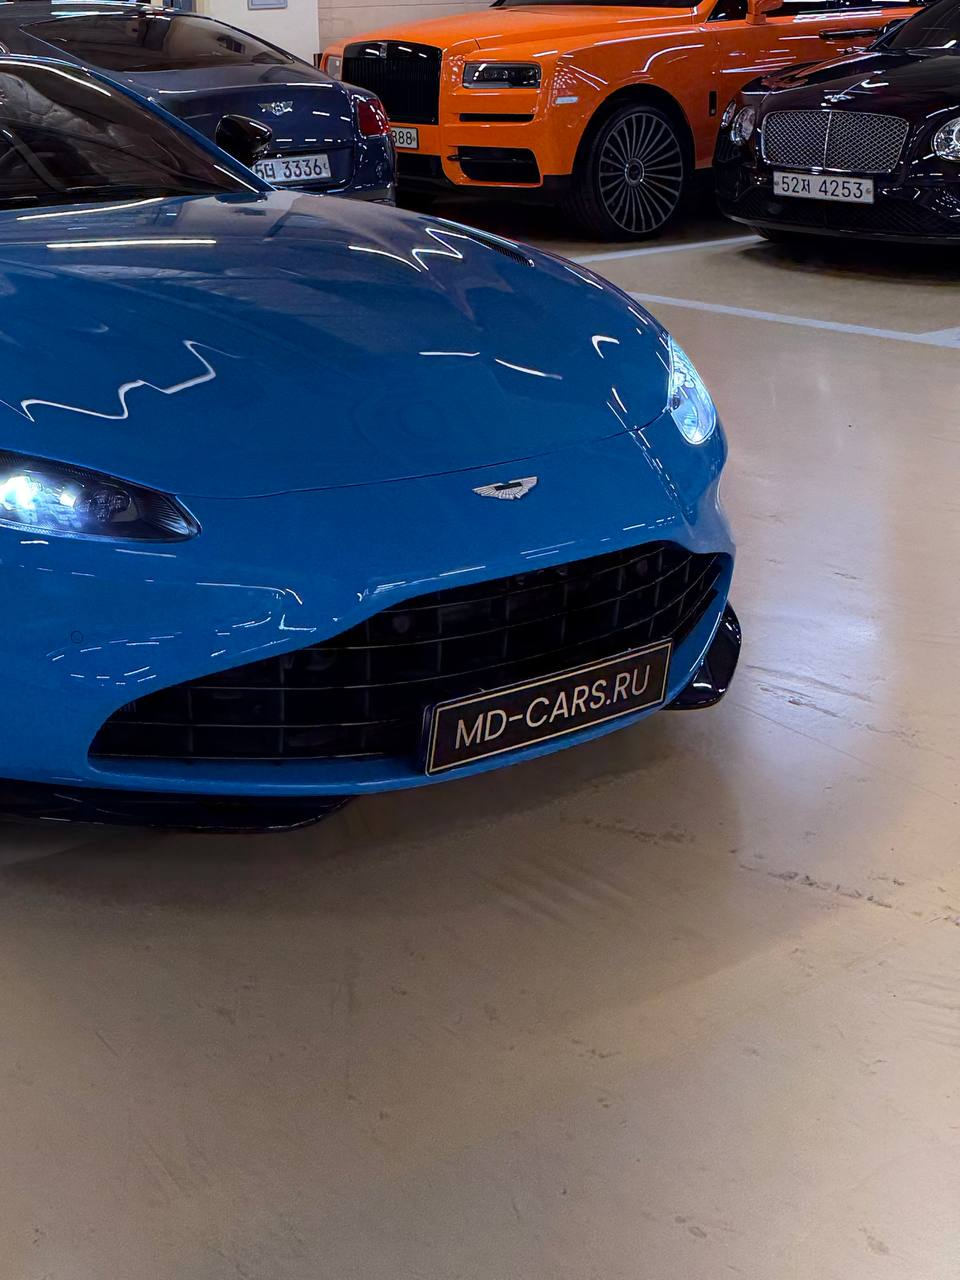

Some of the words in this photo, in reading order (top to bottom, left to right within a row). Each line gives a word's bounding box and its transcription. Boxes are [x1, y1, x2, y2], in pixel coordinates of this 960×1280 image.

[281, 158, 323, 179] 3336
[781, 175, 811, 194] 52저
[818, 179, 863, 199] 4253
[454, 664, 651, 750] MD-CARS.RU
